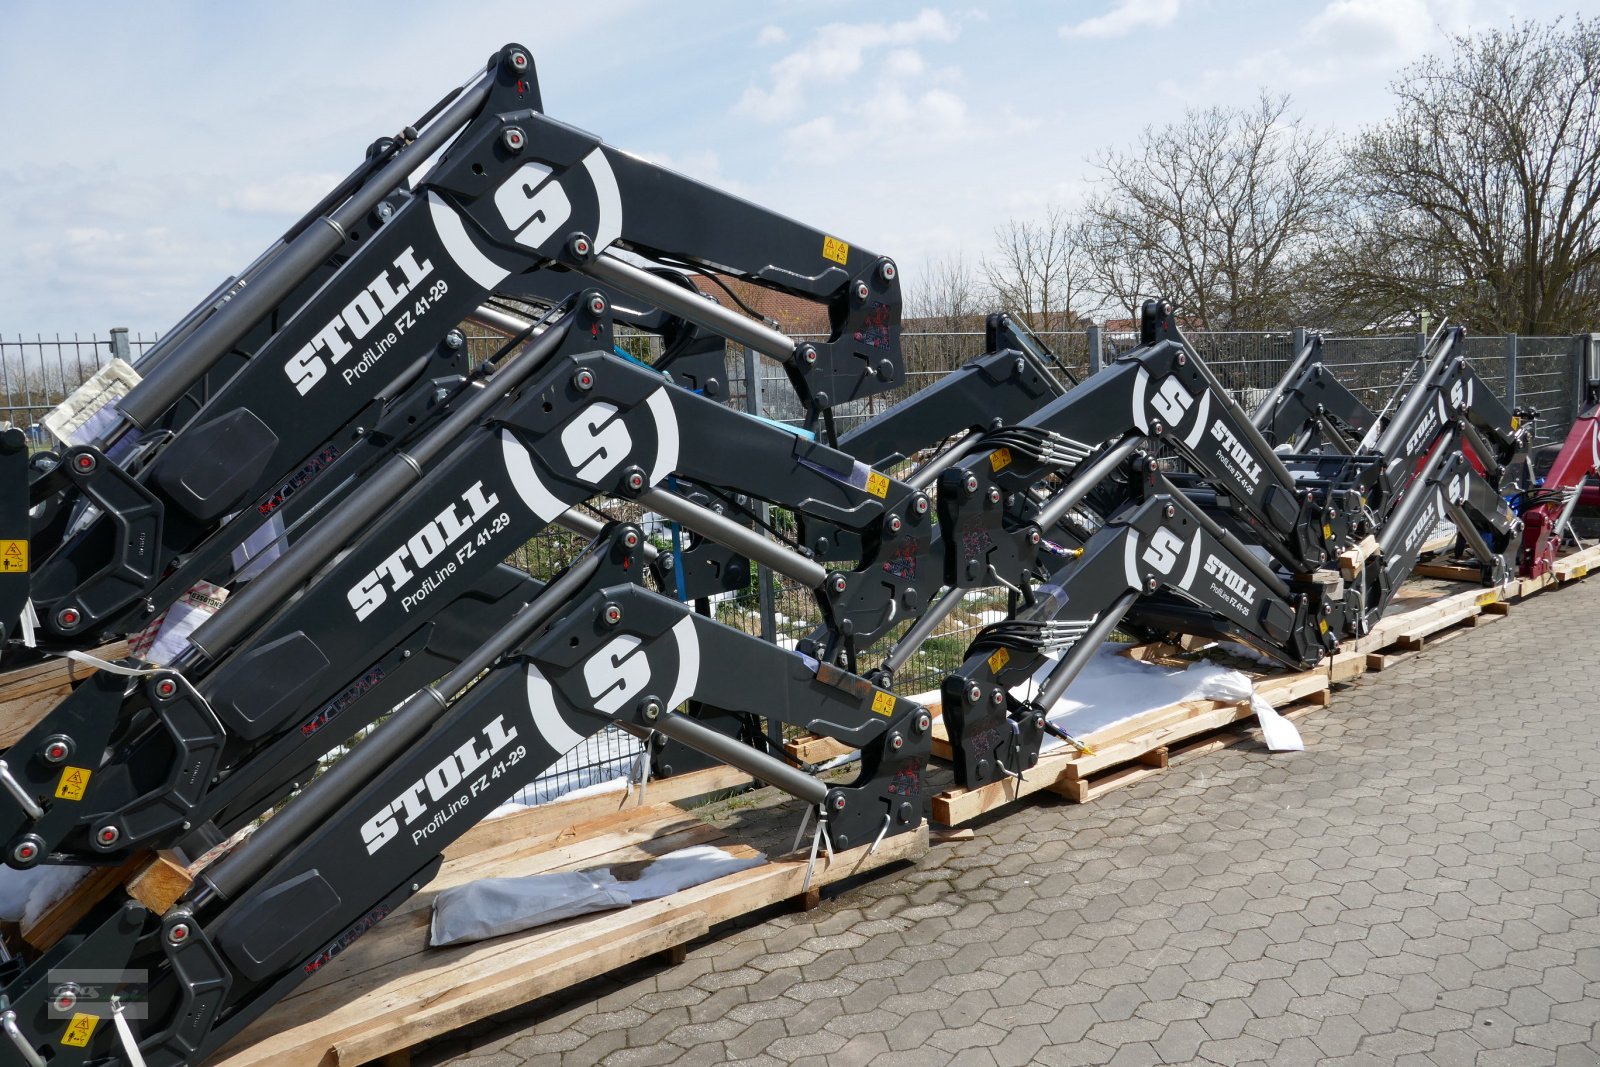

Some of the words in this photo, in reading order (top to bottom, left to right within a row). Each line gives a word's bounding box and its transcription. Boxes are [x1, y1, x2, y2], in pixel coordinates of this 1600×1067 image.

[284, 245, 435, 397] STOLL
[343, 333, 397, 386] ProfiLine
[395, 311, 417, 336] FZ
[415, 280, 448, 316] 41-29
[1211, 418, 1263, 486] STOLL
[347, 480, 500, 622] STOLL
[402, 563, 457, 613] ProfiLine
[456, 542, 476, 565] FZ
[478, 513, 510, 547] 41-29
[1203, 553, 1257, 605] STOLL
[360, 714, 518, 856] STOLL
[412, 796, 469, 846] ProfiLine
[470, 774, 490, 798] FZ
[492, 746, 527, 779] 41-29
